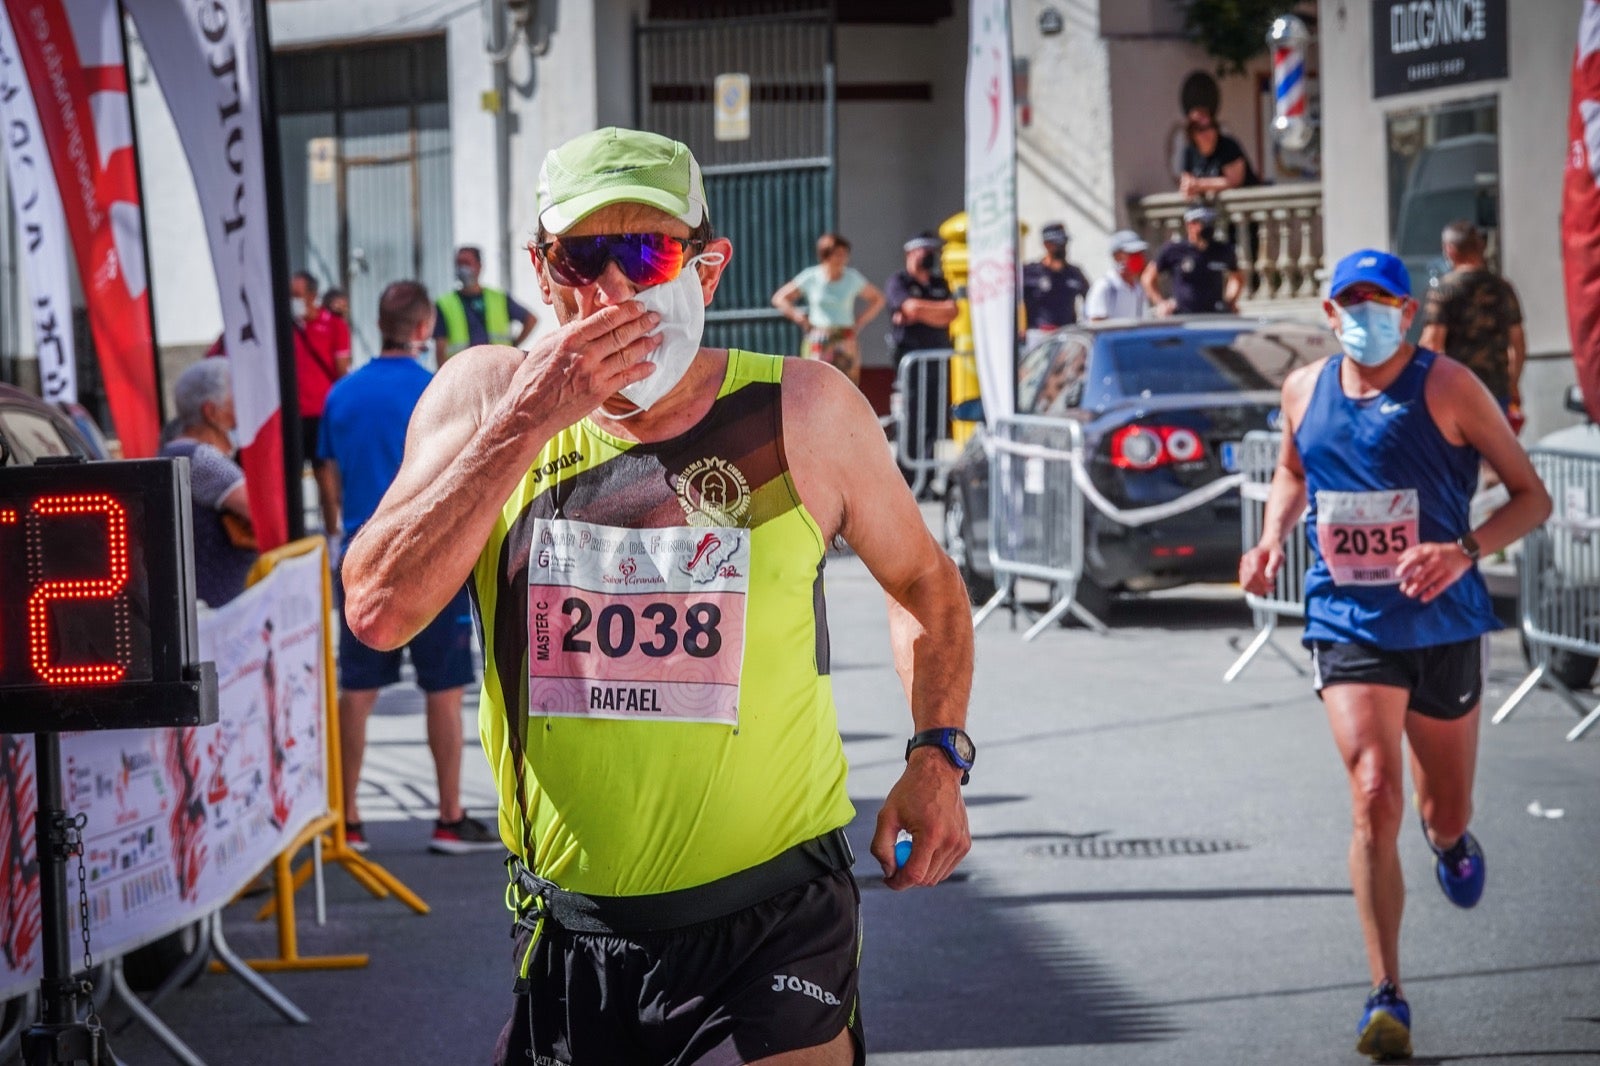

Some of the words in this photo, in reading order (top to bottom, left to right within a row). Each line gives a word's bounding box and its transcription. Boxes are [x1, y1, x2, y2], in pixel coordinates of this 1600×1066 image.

[1333, 525, 1408, 556] 2035
[536, 602, 549, 610] C
[536, 612, 550, 661] MASTER
[561, 596, 722, 659] 2038
[590, 686, 662, 713] RAFAEL
